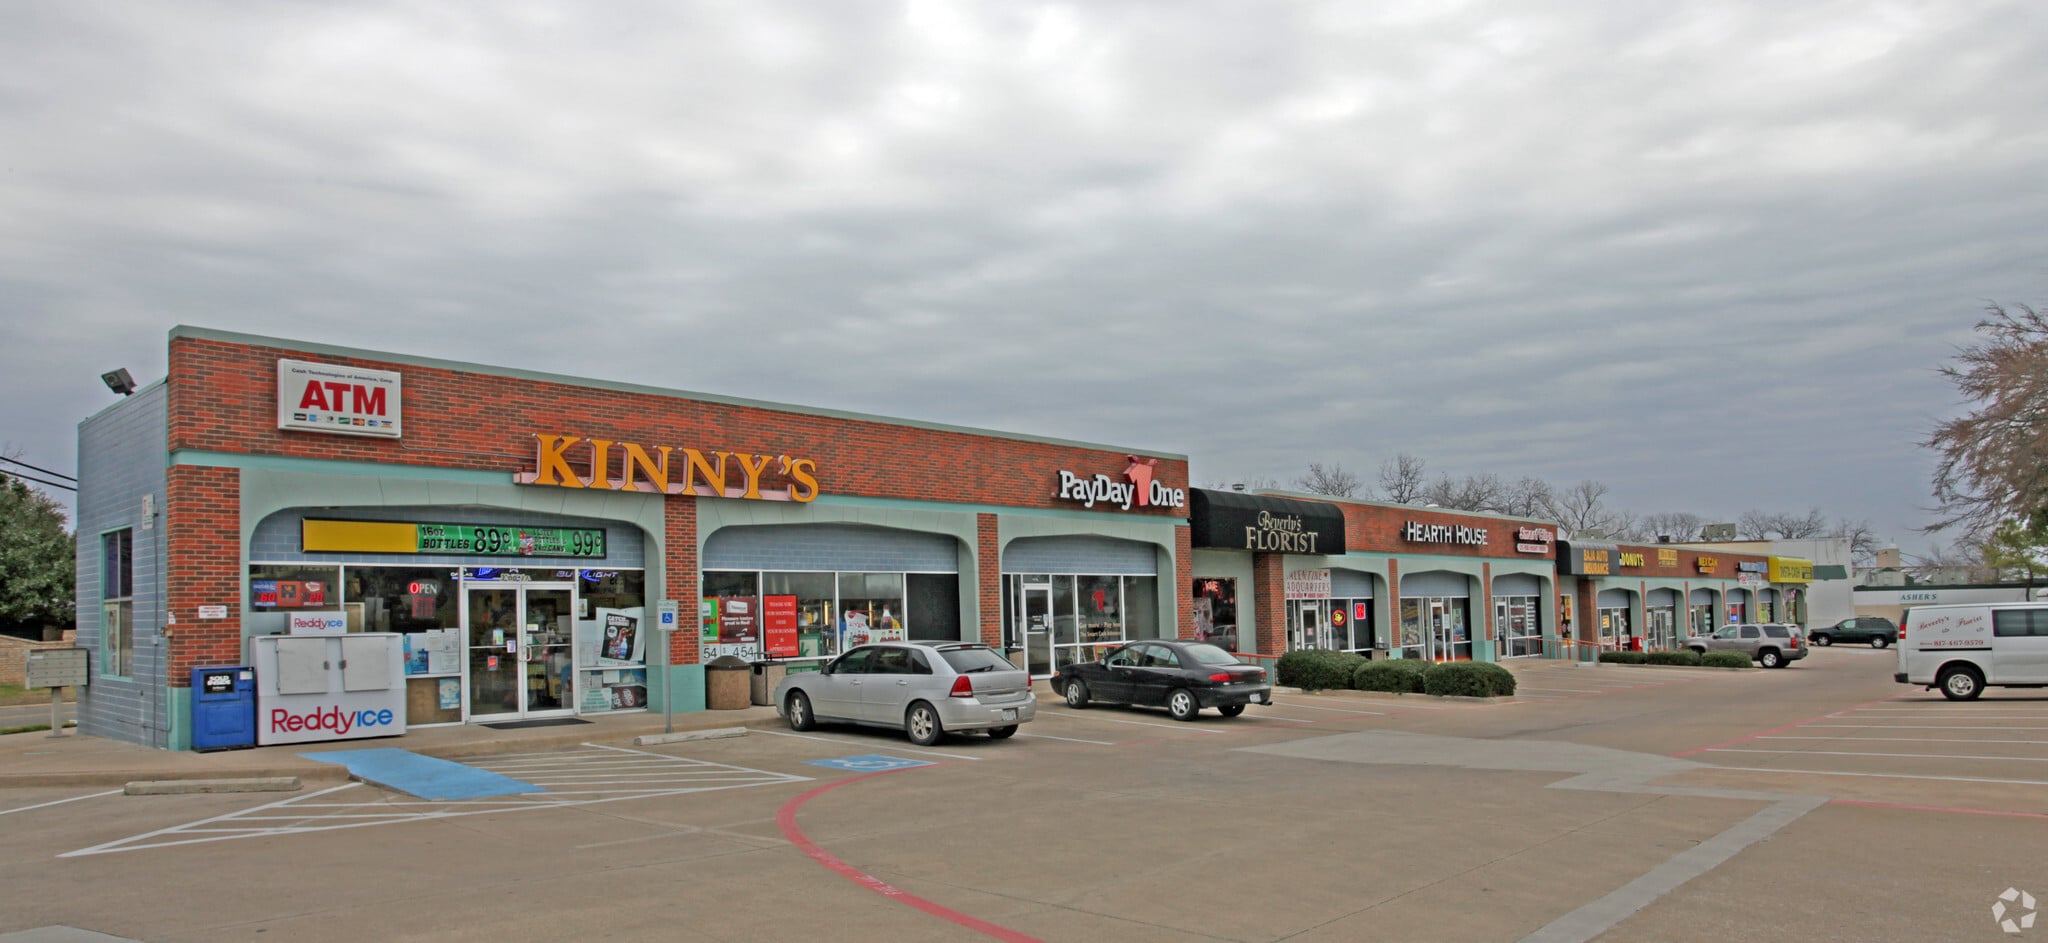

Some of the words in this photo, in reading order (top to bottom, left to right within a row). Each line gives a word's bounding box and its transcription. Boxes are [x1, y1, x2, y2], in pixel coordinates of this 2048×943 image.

[299, 379, 386, 416] ATM
[532, 433, 820, 503] KINNY'S
[1058, 469, 1135, 511] PayDay
[1149, 479, 1185, 508] One
[1257, 510, 1302, 532] Beverly's
[1407, 521, 1452, 543] HEARTH
[1455, 525, 1488, 546] HOUSE
[423, 539, 470, 549] BOTTLES
[1245, 526, 1318, 553] FLORIST
[1621, 552, 1644, 567] DONUTS
[409, 582, 438, 595] OPEN
